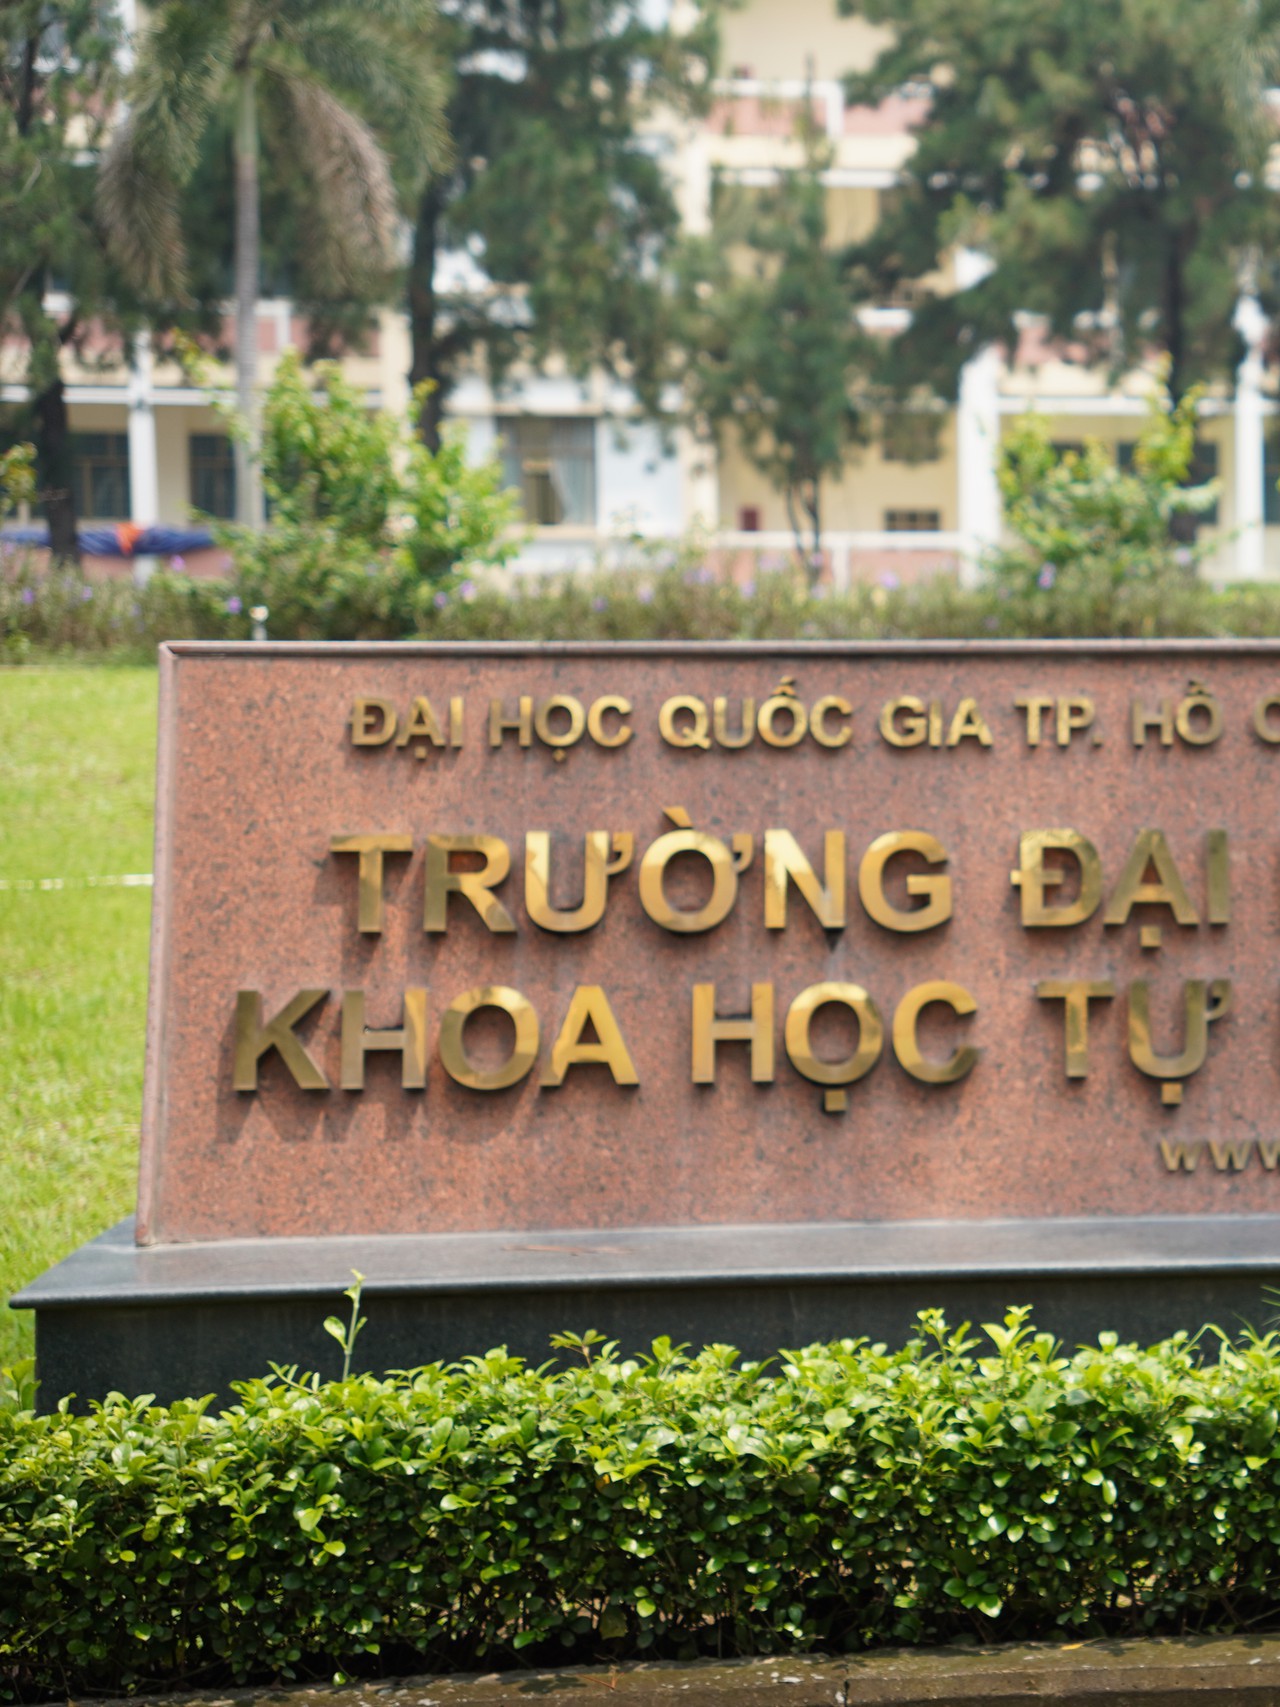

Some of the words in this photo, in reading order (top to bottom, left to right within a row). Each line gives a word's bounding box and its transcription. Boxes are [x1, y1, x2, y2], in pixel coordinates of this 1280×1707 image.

[349, 696, 464, 758] ĐẠI
[489, 696, 633, 761] HỌC
[658, 676, 853, 750] QUỐC
[879, 695, 993, 748] GIA
[1015, 698, 1102, 747] TP.
[1132, 680, 1223, 747] HỒ
[330, 806, 953, 933] TRƯỜNG
[1010, 827, 1230, 949] ĐẠI
[233, 985, 640, 1090] KHOA
[691, 980, 979, 1112] HỌC
[1037, 977, 1231, 1106] TỰ
